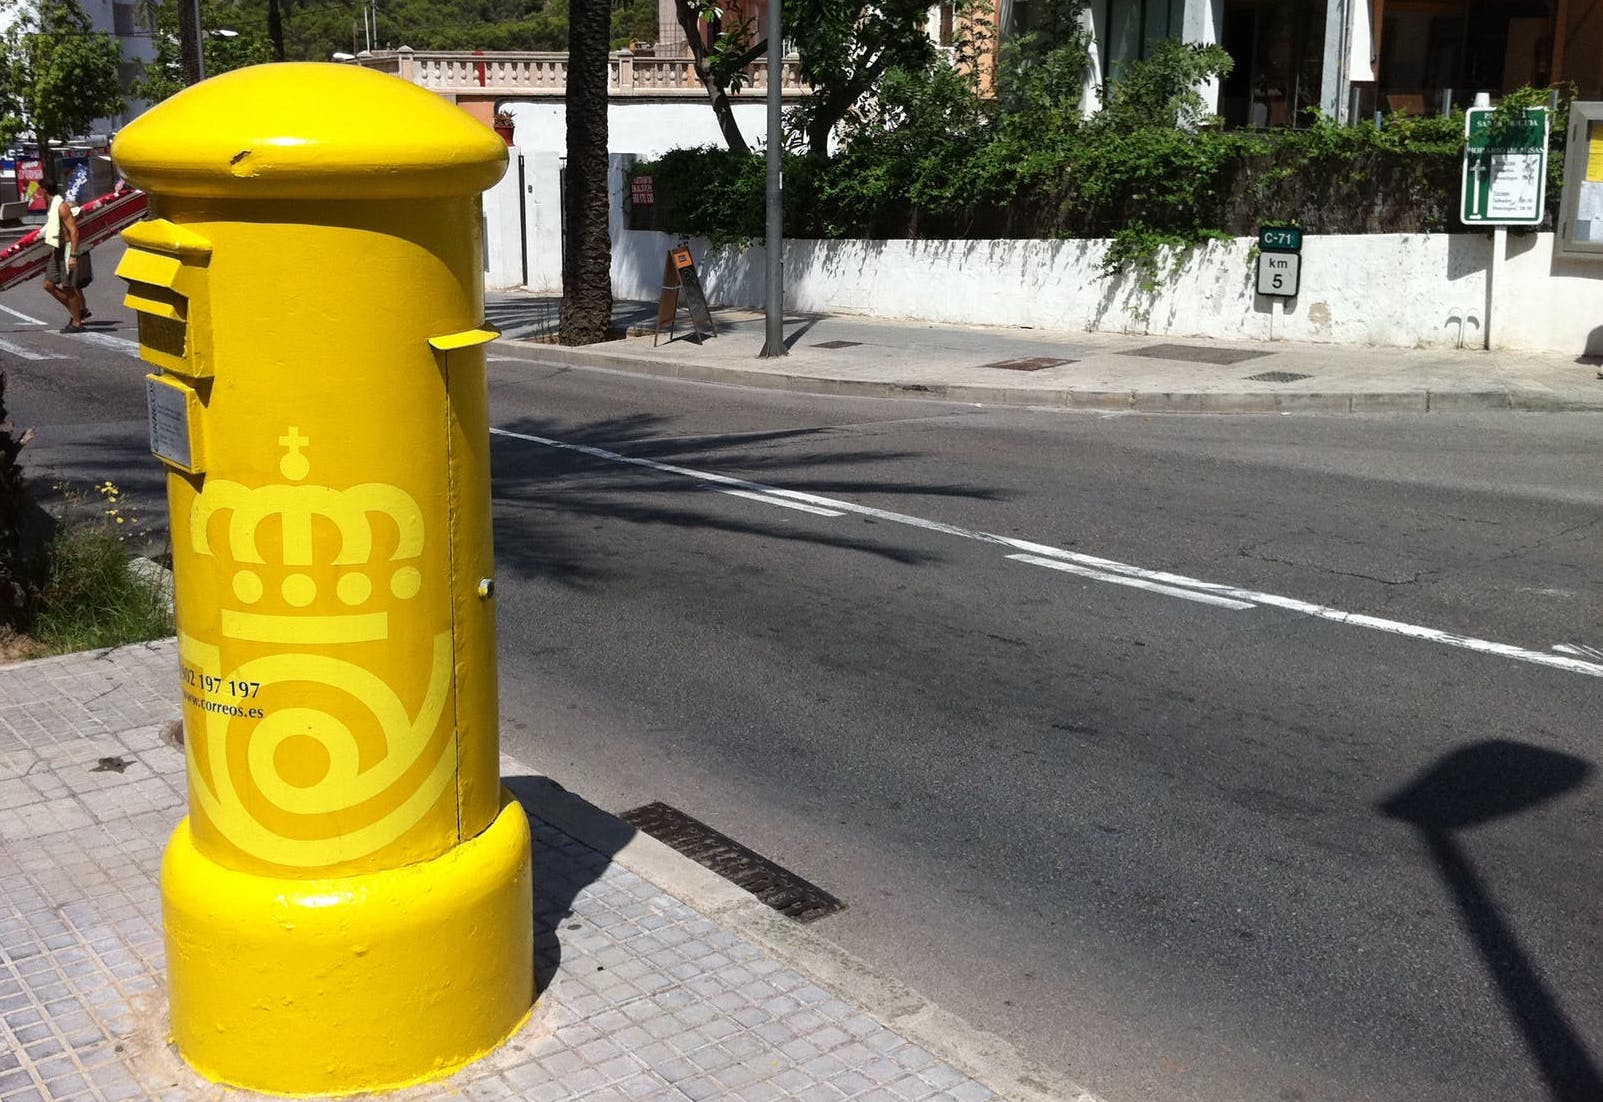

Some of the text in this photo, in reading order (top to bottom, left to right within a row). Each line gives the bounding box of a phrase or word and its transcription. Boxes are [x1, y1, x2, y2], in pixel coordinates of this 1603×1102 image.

[1264, 232, 1292, 245] C-71
[1269, 258, 1288, 268] km
[1272, 274, 1283, 289] 5
[199, 674, 222, 693] 197
[229, 680, 260, 698] 197
